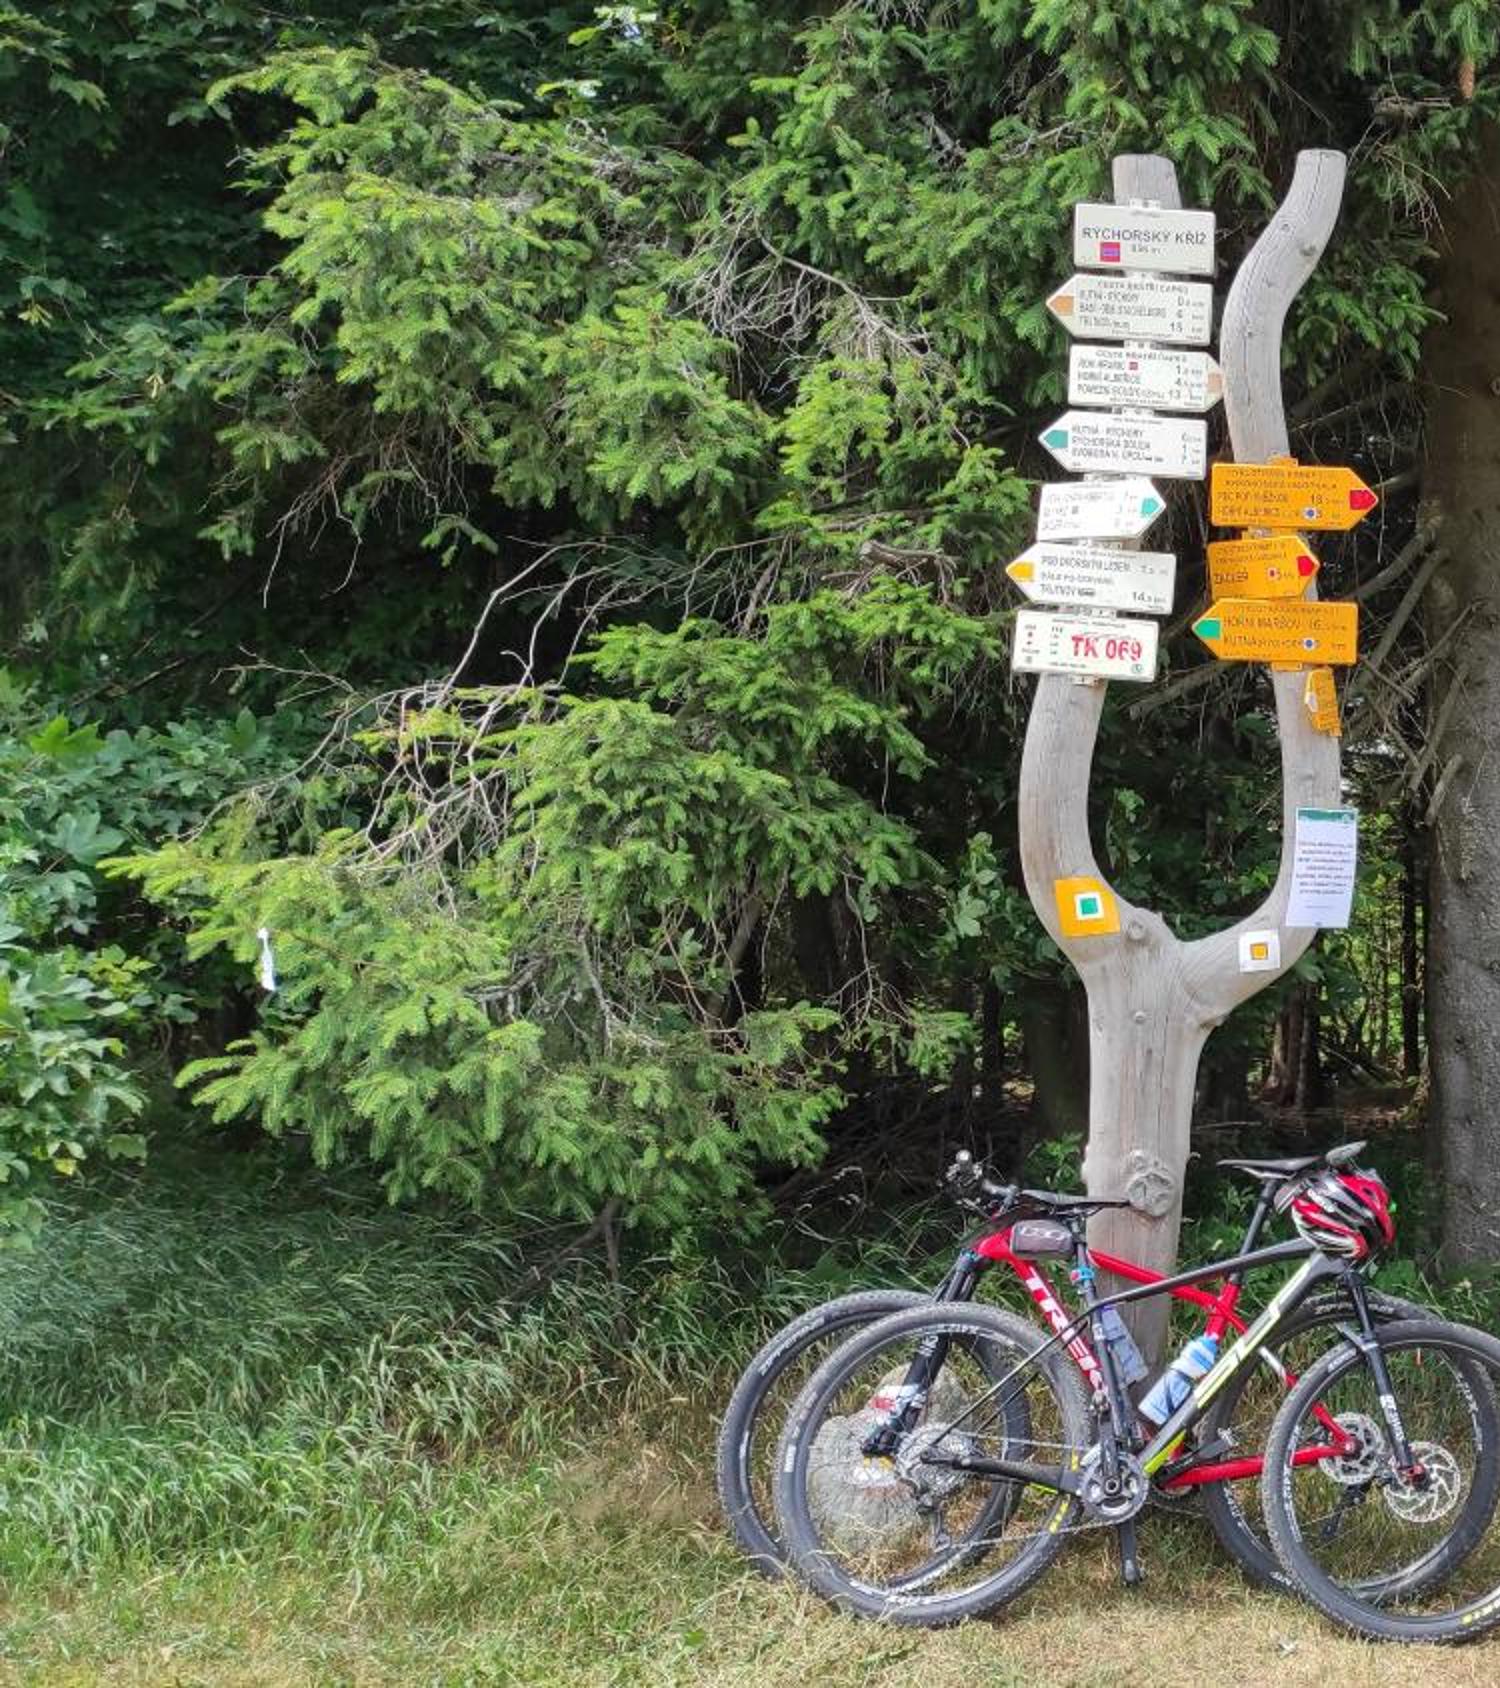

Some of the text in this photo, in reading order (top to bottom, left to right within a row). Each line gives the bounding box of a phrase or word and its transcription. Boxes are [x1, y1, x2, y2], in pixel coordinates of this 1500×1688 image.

[1071, 634, 1099, 658] TK
[1104, 638, 1143, 661] 069
[1026, 1264, 1110, 1399] TREK
